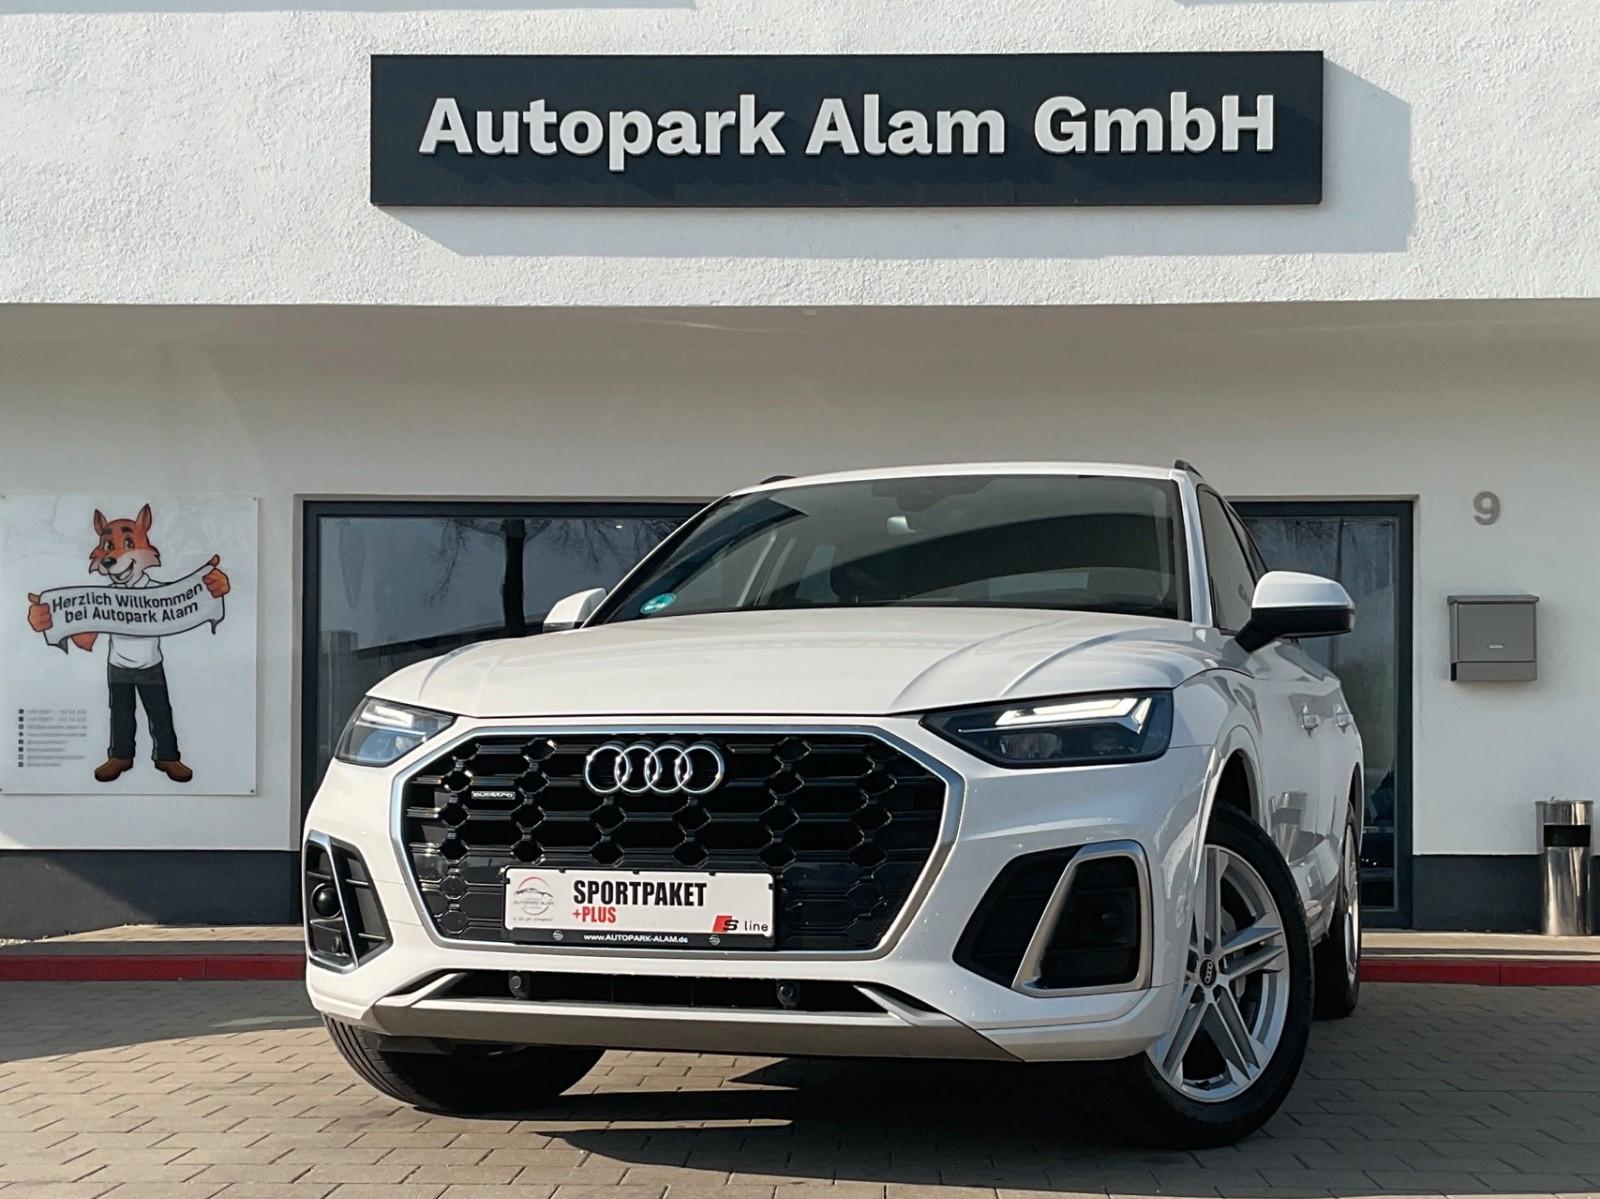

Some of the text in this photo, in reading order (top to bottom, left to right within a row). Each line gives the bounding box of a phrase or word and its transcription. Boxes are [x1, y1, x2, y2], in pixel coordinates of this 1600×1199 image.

[418, 91, 1276, 172] Autopark Alam GmbH
[1473, 491, 1501, 525] 9
[52, 582, 204, 613] Herzlich Willkommen
[65, 602, 199, 624] bei Autopark Alam
[573, 879, 707, 907] SPORTPAKET
[572, 906, 617, 924] +PLUS
[745, 920, 769, 932] line
[583, 933, 689, 944] www.AUTOPARK-ALAM.de
